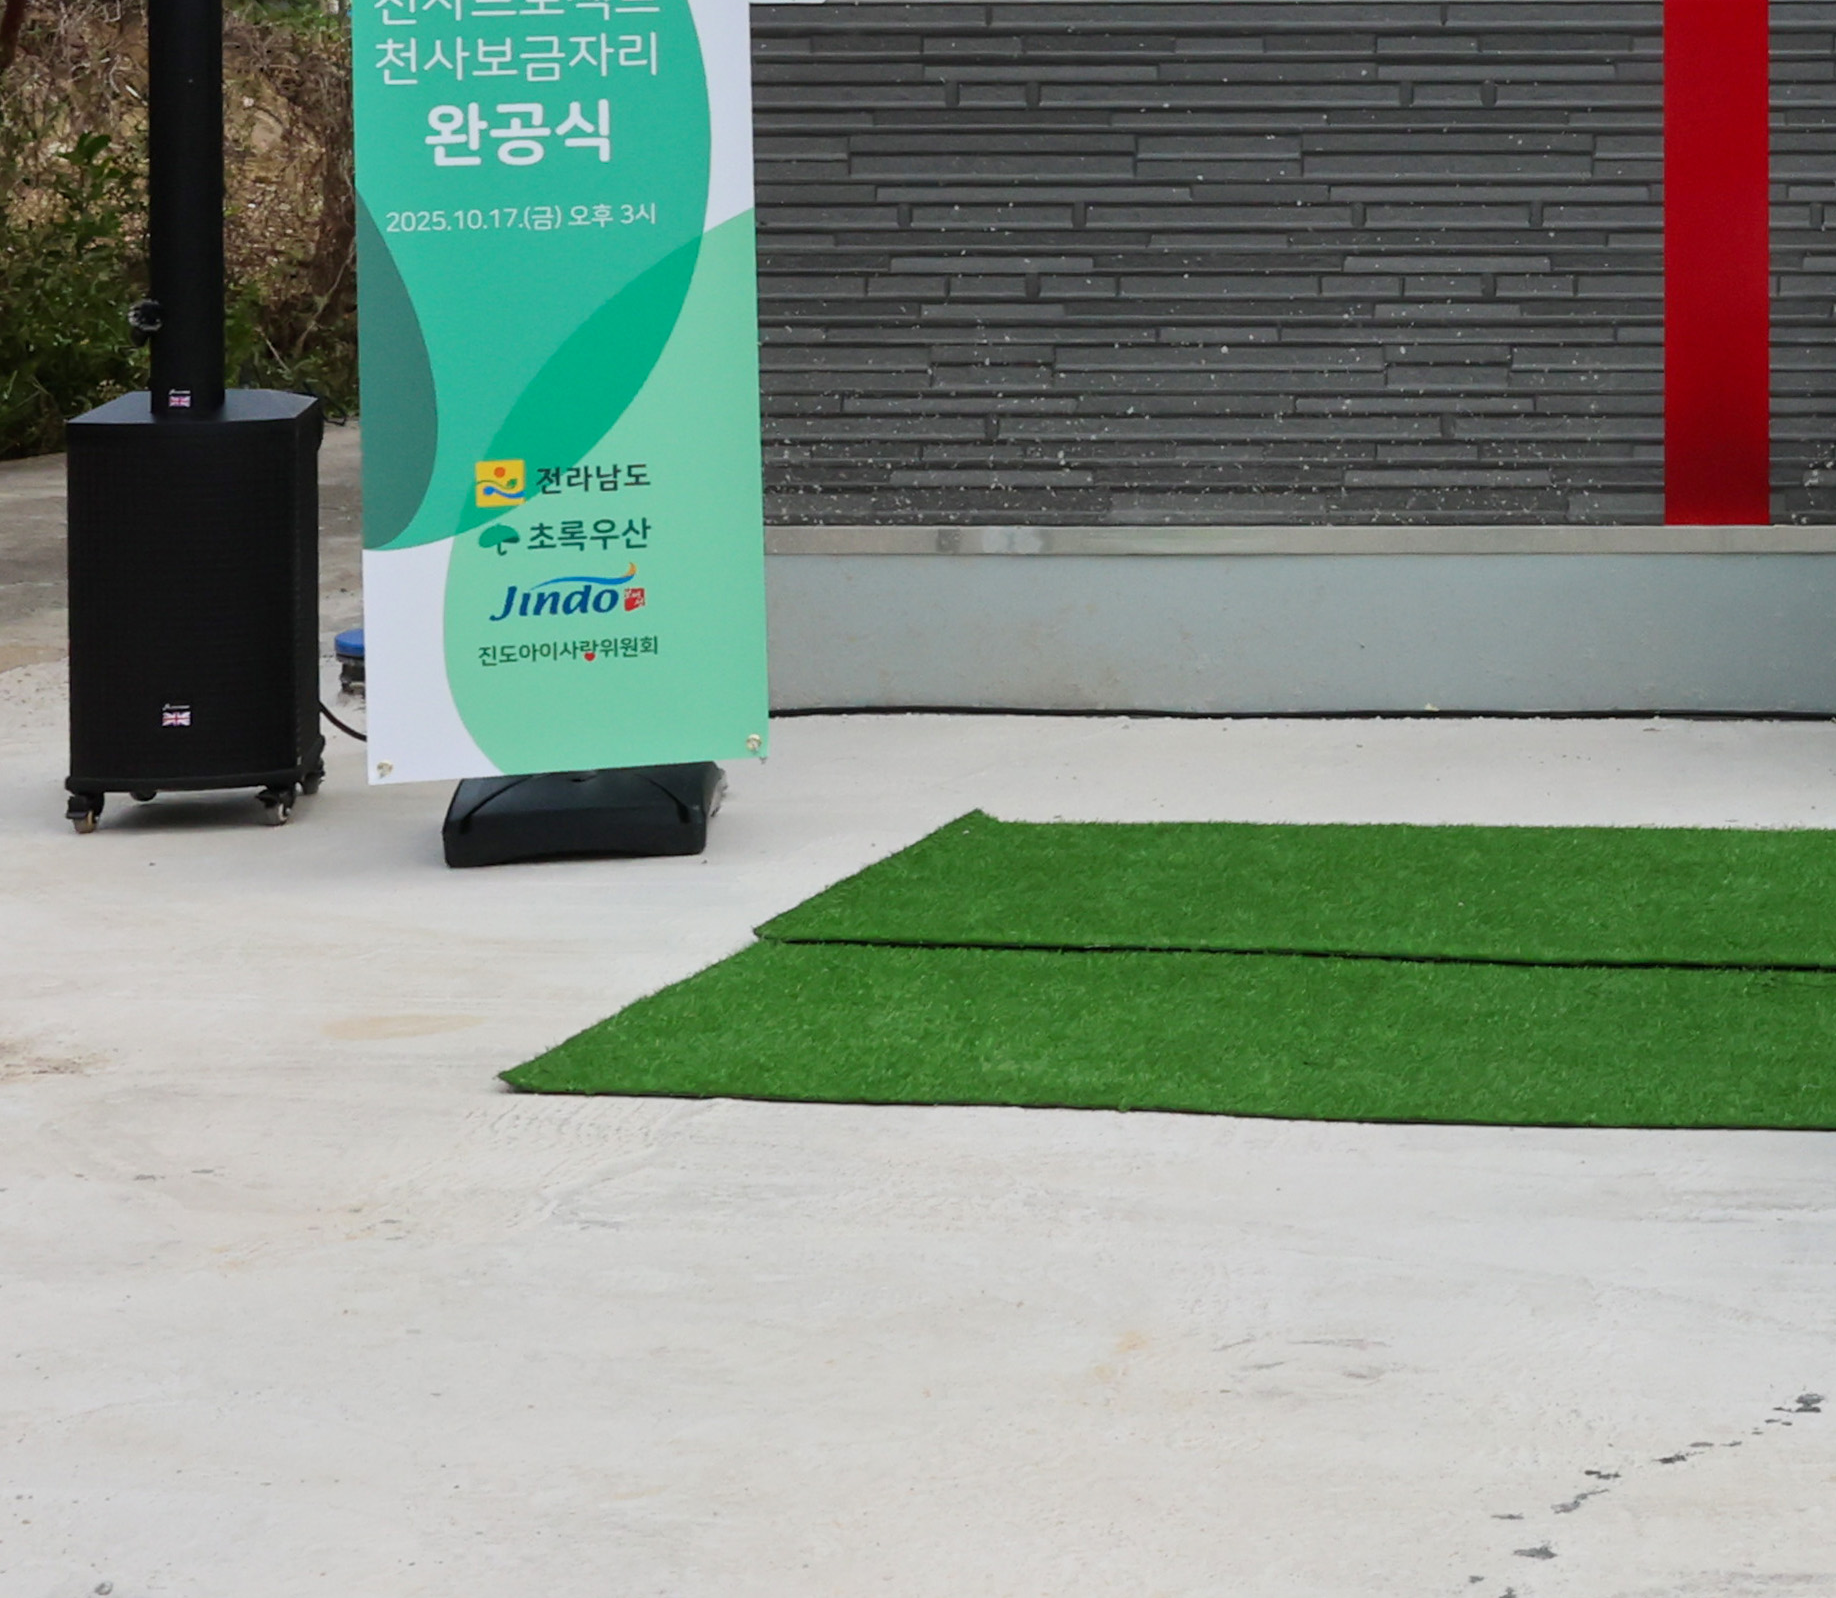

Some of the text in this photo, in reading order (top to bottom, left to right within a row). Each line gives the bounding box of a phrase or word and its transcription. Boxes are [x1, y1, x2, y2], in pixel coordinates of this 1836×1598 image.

[375, 31, 657, 85] 천사보금자리
[424, 98, 611, 167] 완공식
[385, 202, 656, 233] 2025.10.17.(금) 오후 3시
[536, 463, 651, 495] 전라남도
[527, 517, 652, 552] 초록우산
[489, 585, 619, 622] Jindo
[478, 635, 658, 667] 진도아이사랑위원회
